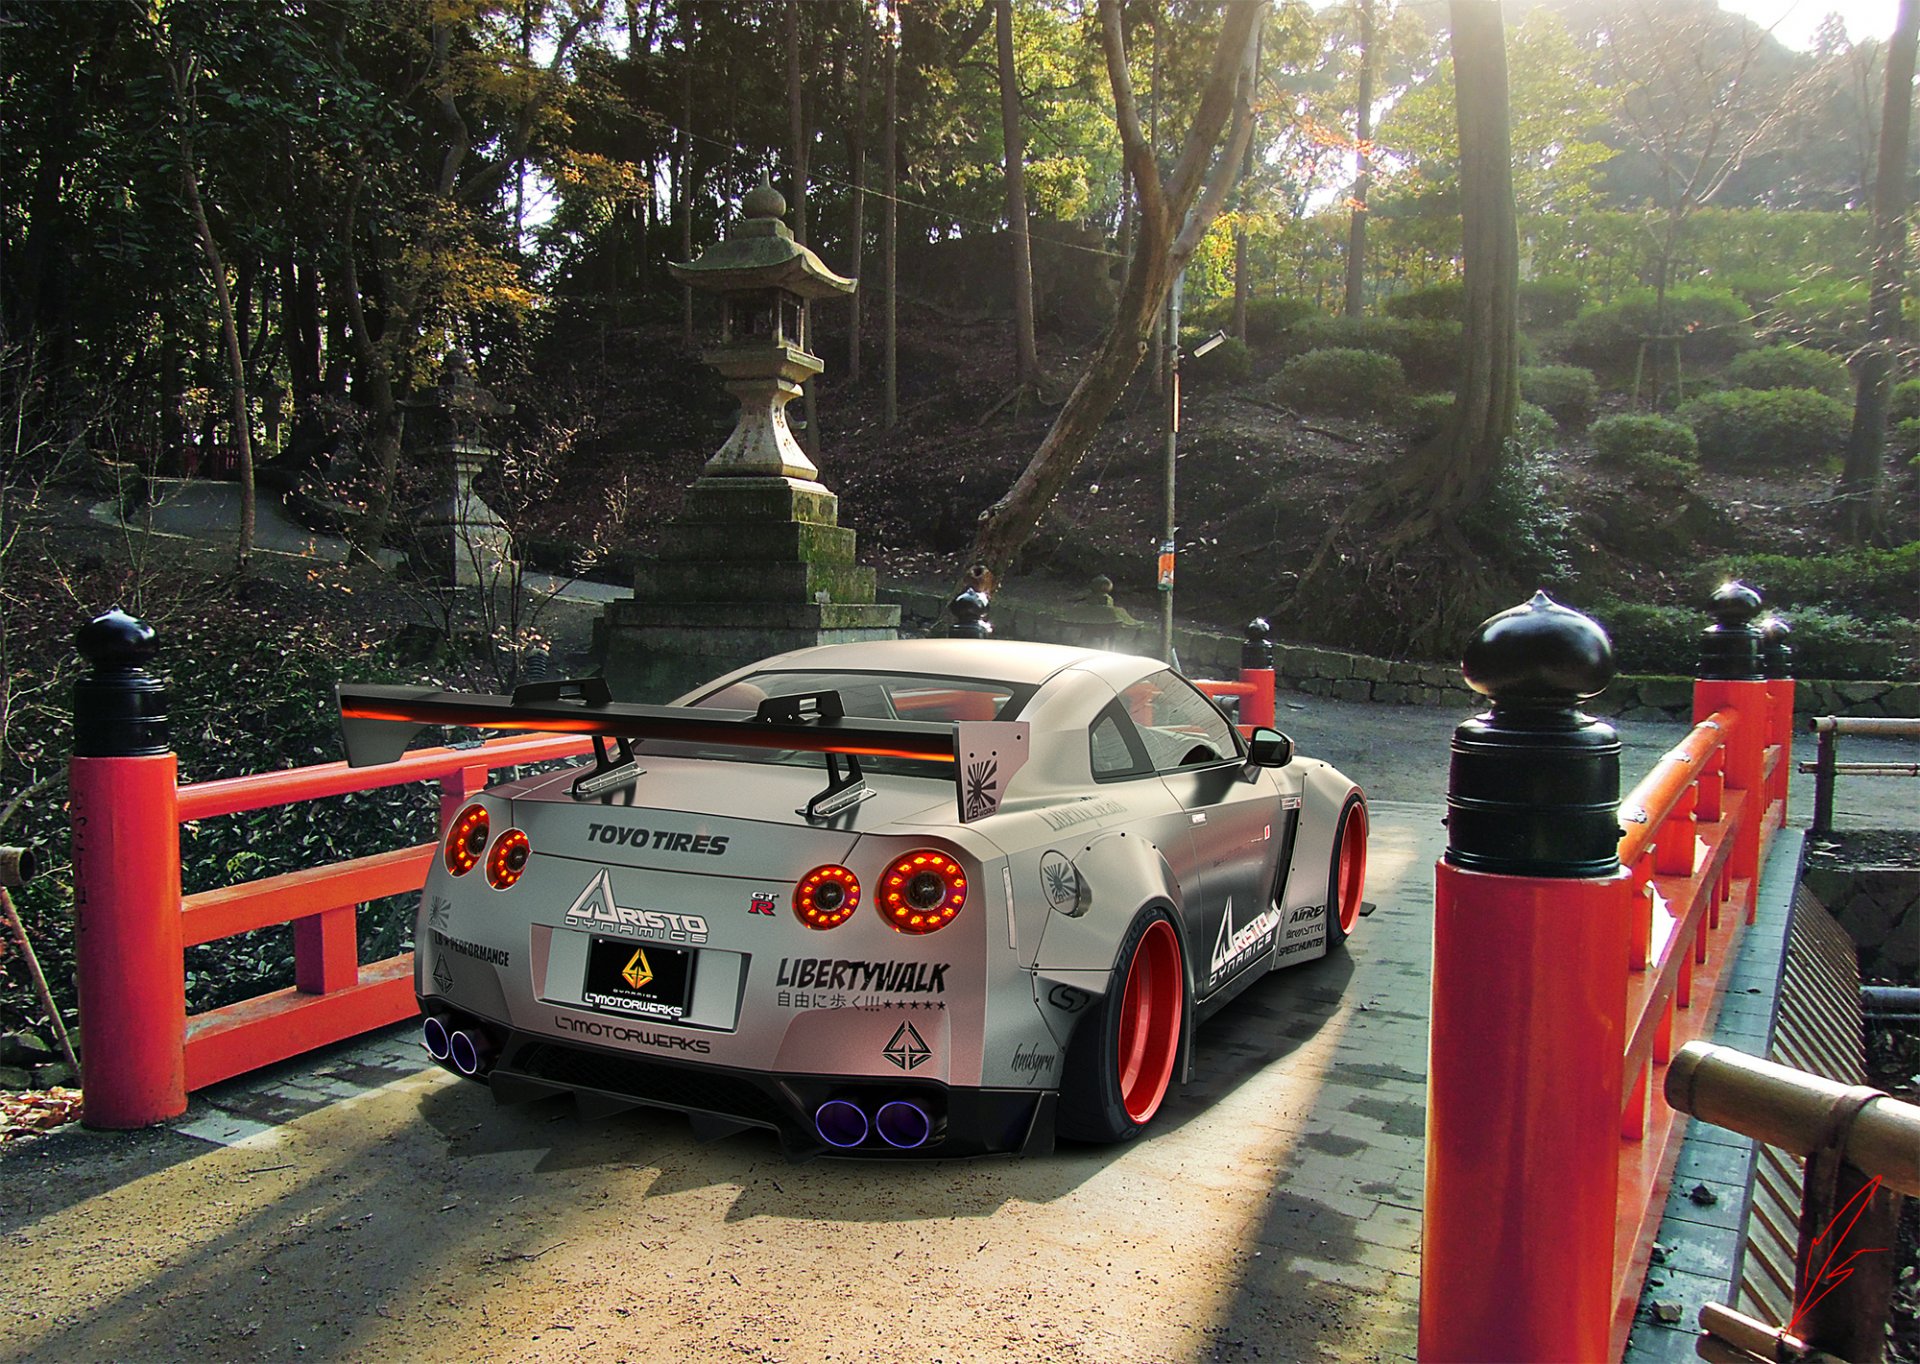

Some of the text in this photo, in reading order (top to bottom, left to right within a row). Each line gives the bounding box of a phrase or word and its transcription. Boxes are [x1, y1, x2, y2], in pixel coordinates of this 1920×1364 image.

[587, 823, 730, 856] TOYO TIRES
[565, 866, 710, 935] ARISTO
[564, 915, 709, 944] DYNAMICS
[450, 937, 510, 967] PERFORMANCE
[1208, 931, 1272, 987] DYNAMICS
[776, 957, 951, 994] LIBERTYWALK
